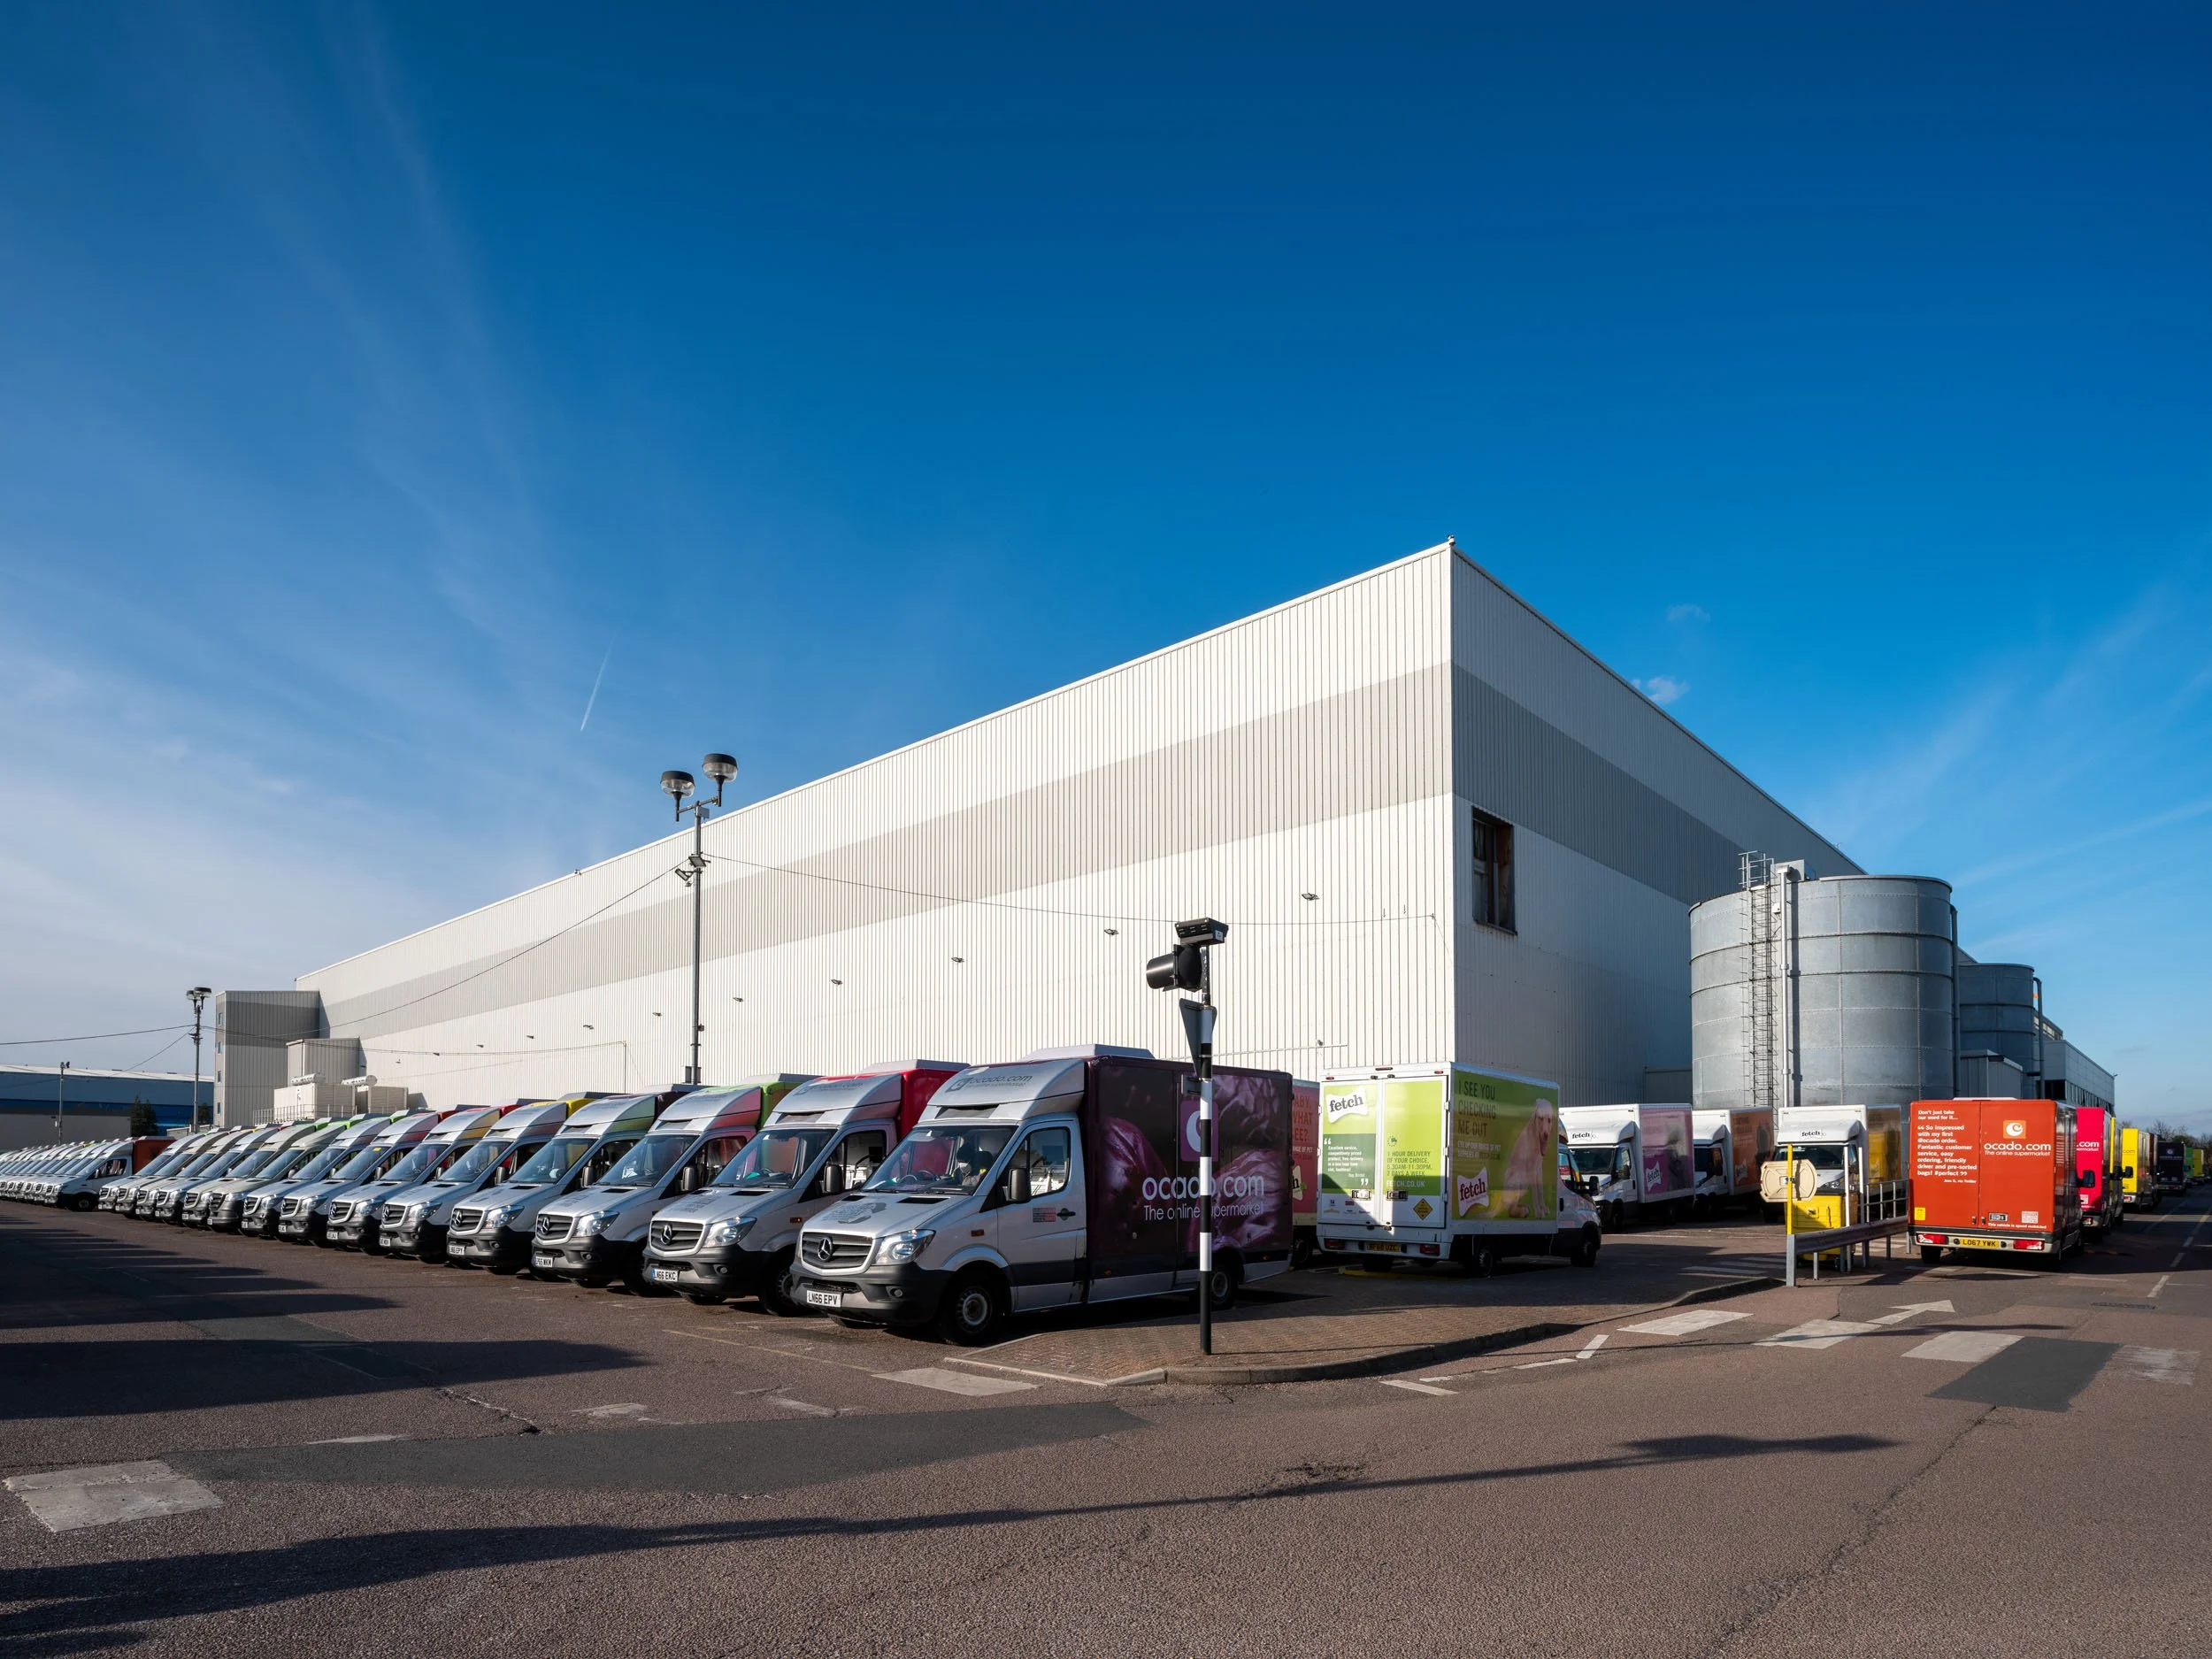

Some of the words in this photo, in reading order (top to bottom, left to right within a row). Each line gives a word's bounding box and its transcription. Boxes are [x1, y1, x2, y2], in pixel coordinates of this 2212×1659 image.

[1463, 1081, 1478, 1097] SEE
[1480, 1083, 1495, 1101] YOU
[1330, 1094, 1363, 1112] fetch
[1458, 1100, 1496, 1119] CHECKING
[1472, 1121, 1487, 1137] OUT
[1984, 1141, 2051, 1151] ocado.com
[1460, 1178, 1486, 1201] fetch
[1144, 1204, 1164, 1220] The
[1168, 1202, 1201, 1219] online
[1210, 1202, 1263, 1218] upermarket
[824, 1294, 838, 1305] EPV
